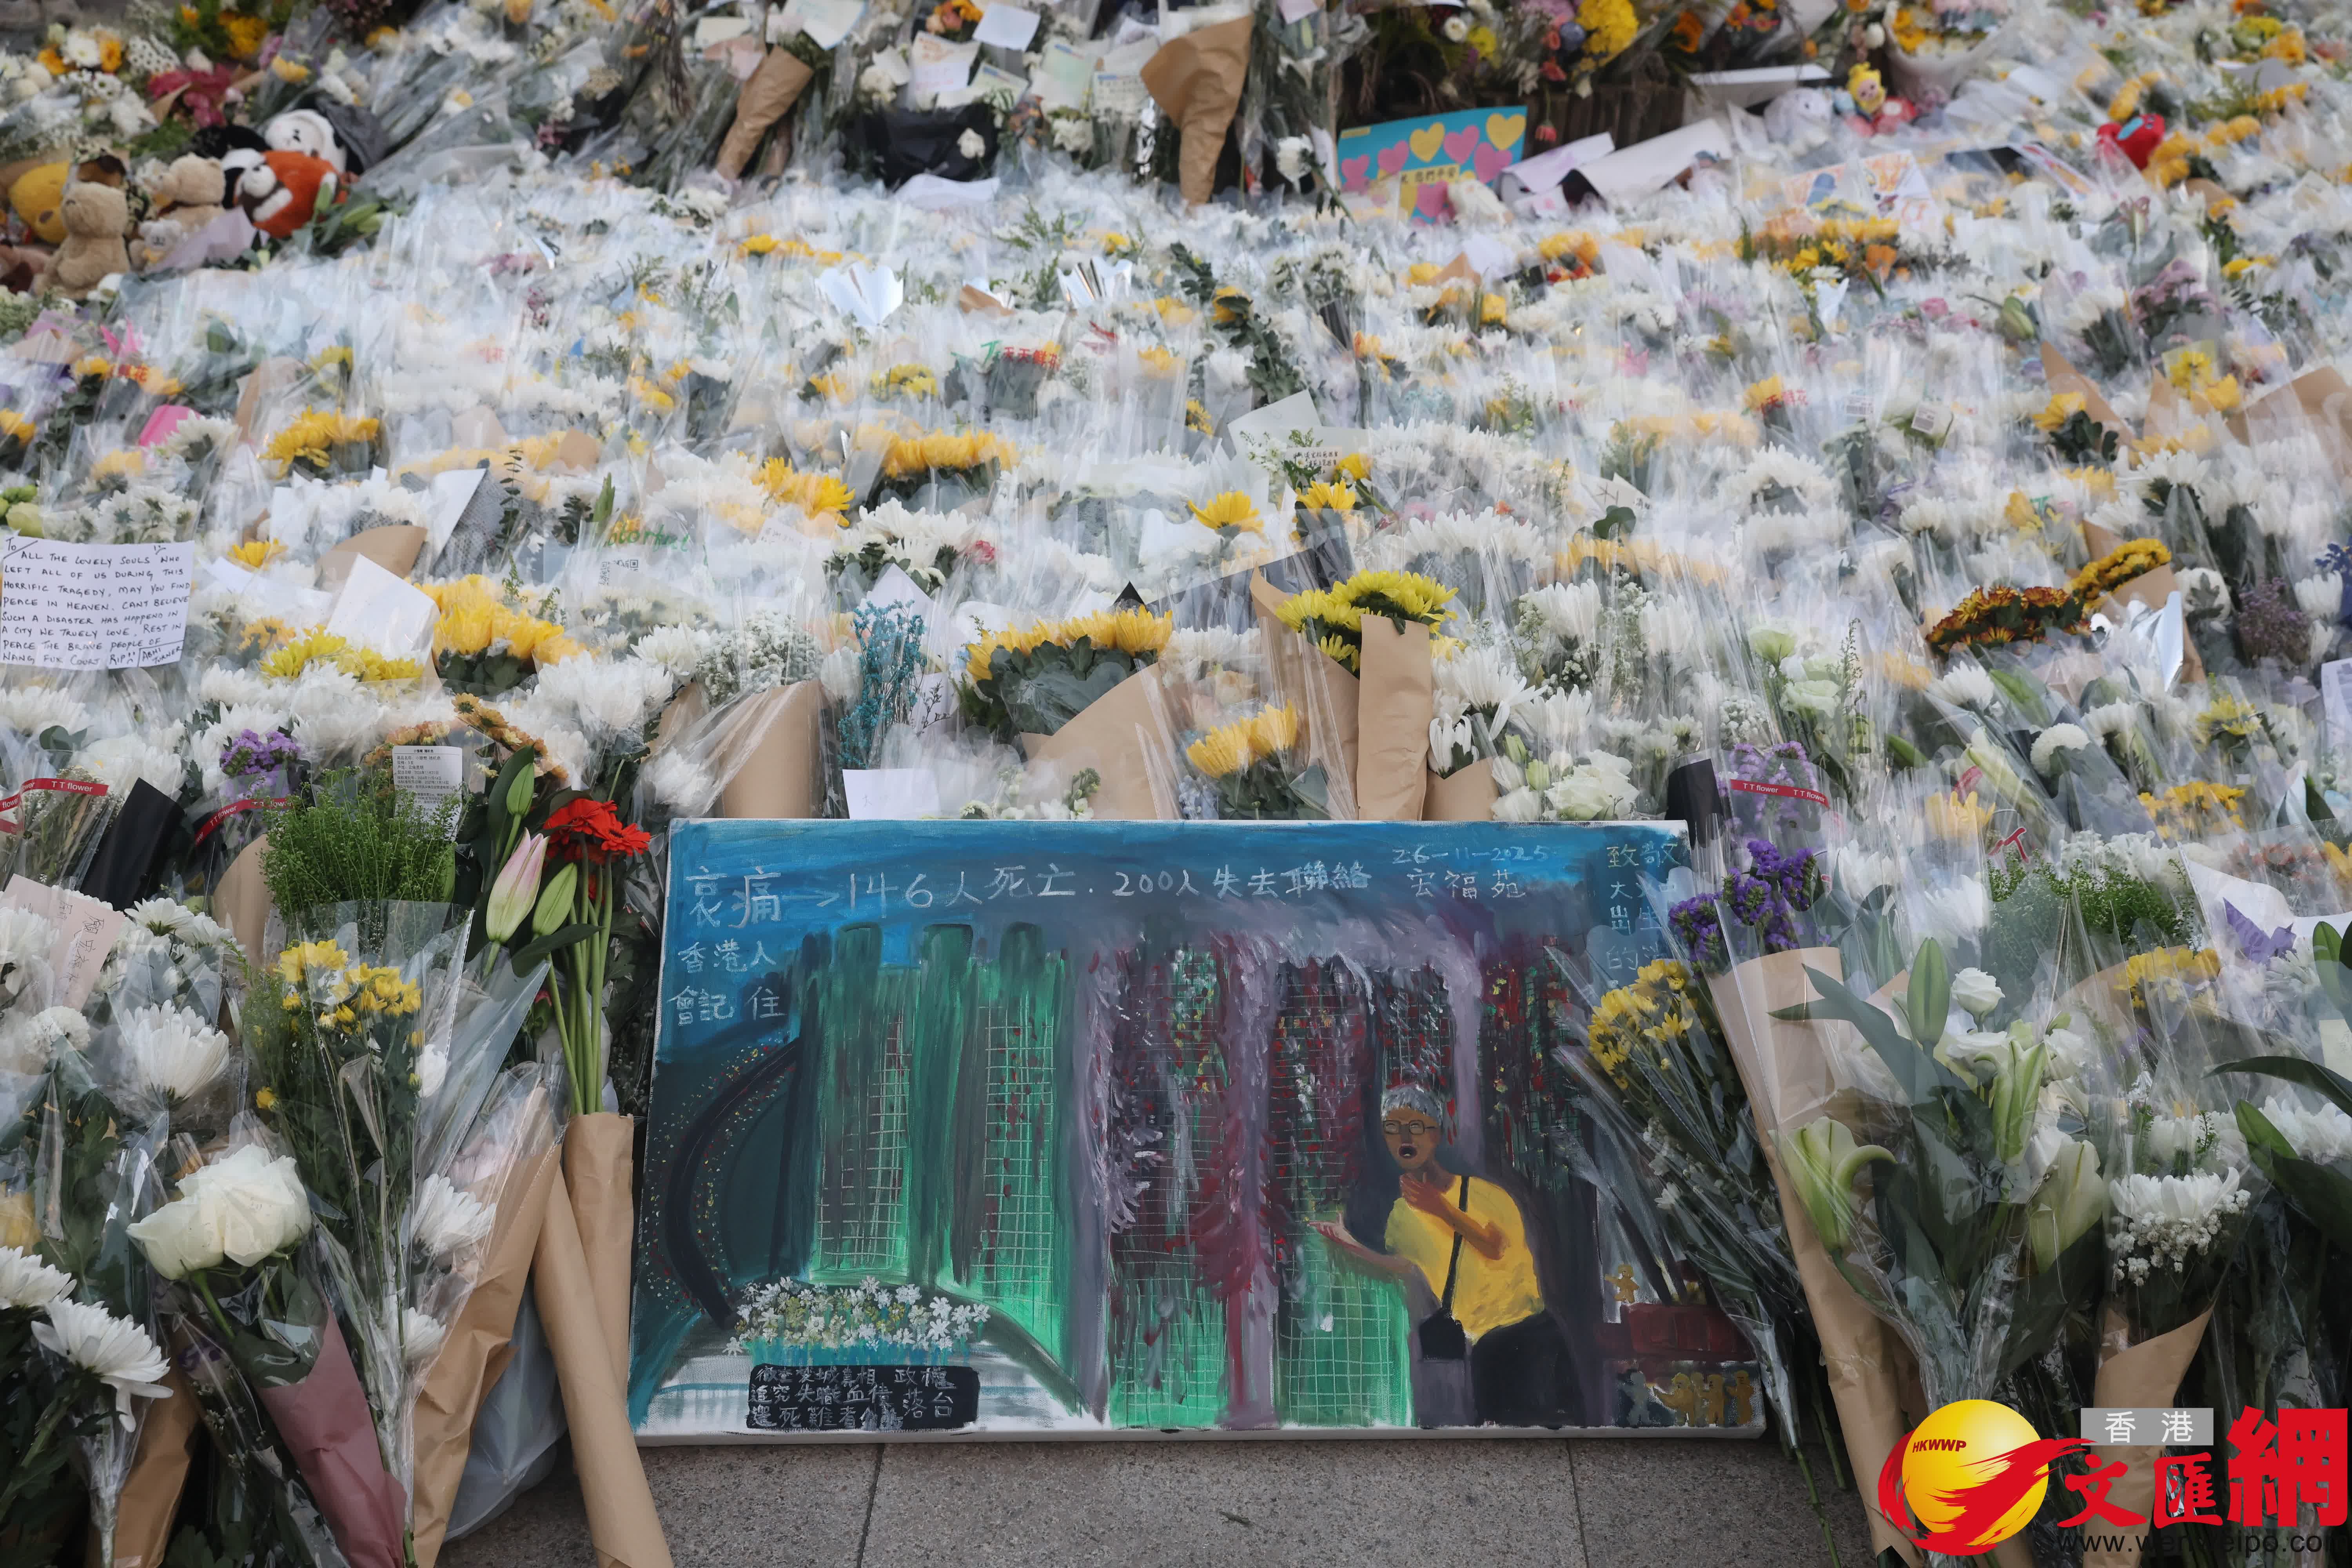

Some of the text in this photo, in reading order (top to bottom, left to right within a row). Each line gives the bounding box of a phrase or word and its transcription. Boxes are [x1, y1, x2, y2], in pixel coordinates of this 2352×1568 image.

[6, 537, 16, 551] To
[21, 551, 43, 559] ALL
[50, 553, 68, 562] THE
[75, 556, 112, 568] LOVELY
[120, 556, 150, 565] SOULS
[5, 565, 31, 574] LEFT
[115, 571, 153, 581] DURING
[4, 581, 49, 592] HORRIFIC
[119, 586, 142, 594] MAY
[151, 584, 165, 595] YOU
[3, 597, 38, 608] PEACE
[122, 601, 148, 610] CANT
[154, 596, 191, 606] BELIEVE
[2, 611, 25, 622] SUCH
[47, 615, 94, 624] DISASTER
[124, 613, 163, 624] HAPPEND
[15, 627, 32, 637] CITY
[60, 628, 98, 640] TRUELY
[143, 624, 167, 634] REST
[3, 637, 161, 652] PEACE THE BRAVE PEOPLE OF
[152, 646, 183, 664] TURNER
[67, 782, 93, 792] flower
[1756, 785, 1778, 793] flower
[1806, 791, 1825, 802] flower
[2, 798, 19, 809] flower
[218, 805, 238, 819] flower
[1392, 844, 1550, 864] 26-11-2025
[1606, 841, 1681, 867] 致敬
[1406, 868, 1526, 899] 宏福苑
[685, 866, 781, 928] 哀痛
[678, 938, 776, 973] 香港人
